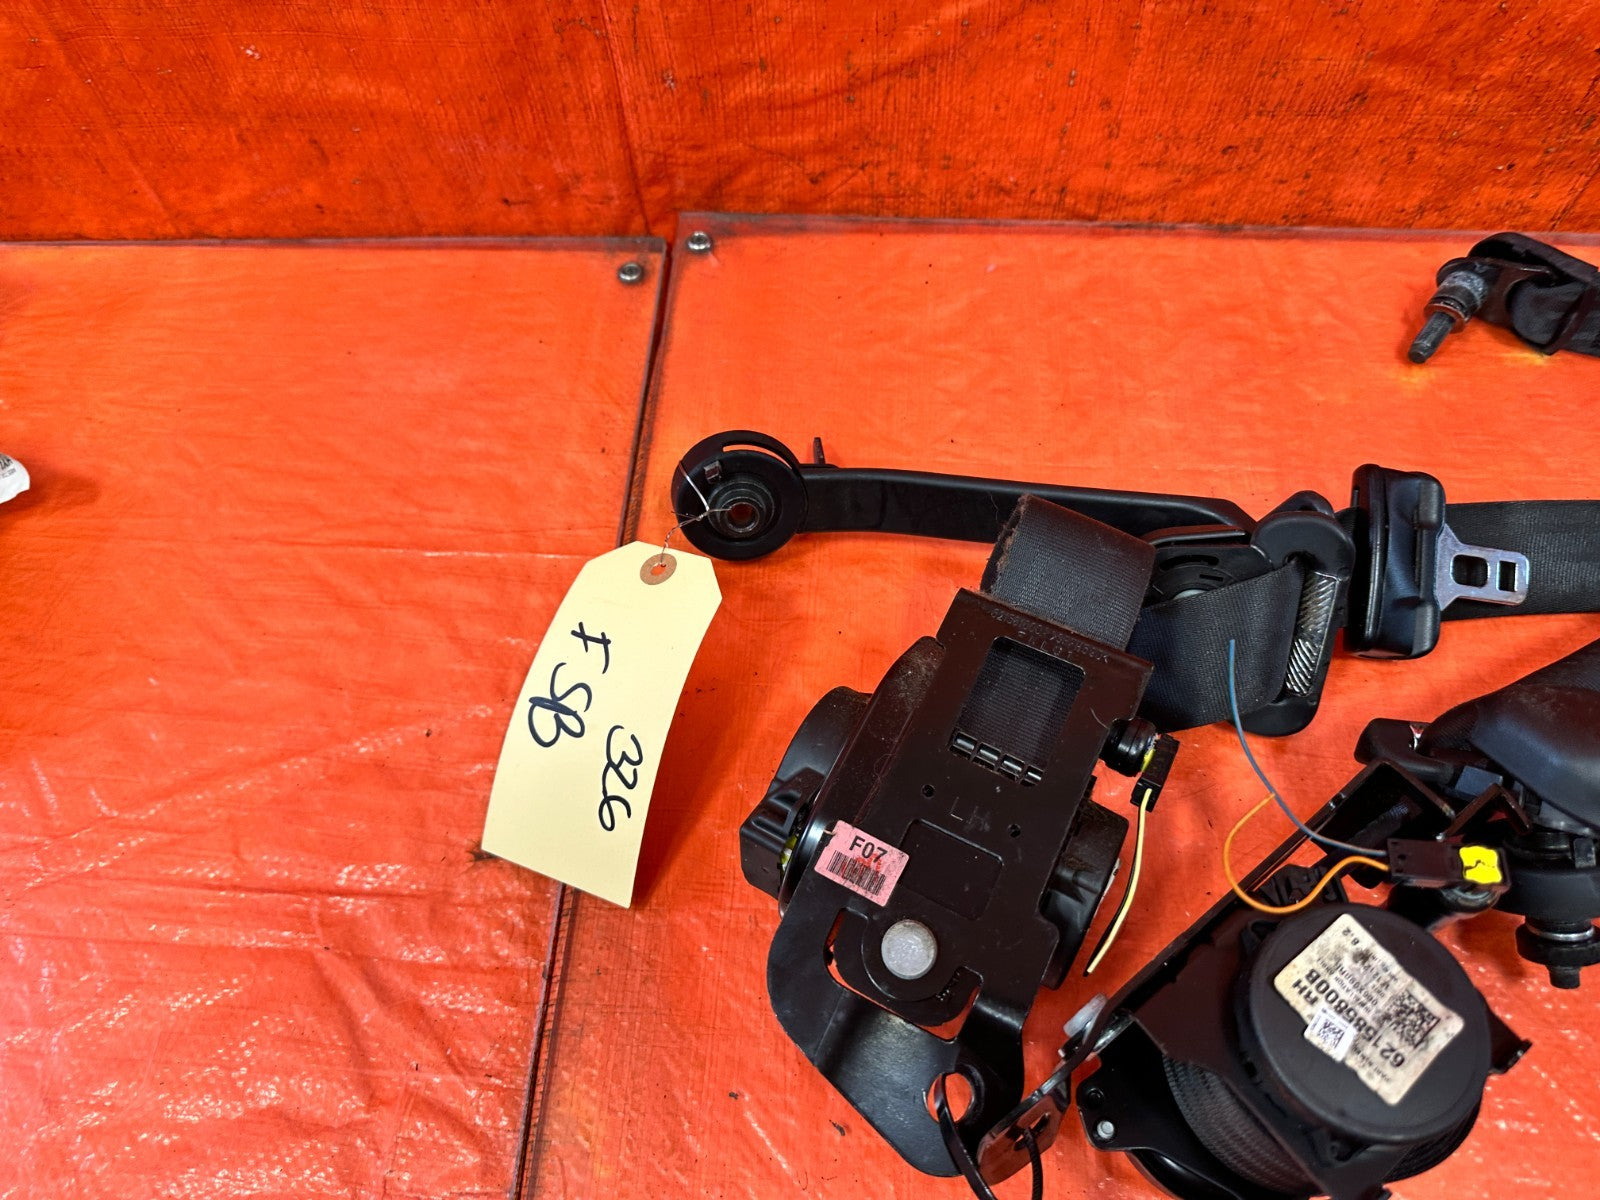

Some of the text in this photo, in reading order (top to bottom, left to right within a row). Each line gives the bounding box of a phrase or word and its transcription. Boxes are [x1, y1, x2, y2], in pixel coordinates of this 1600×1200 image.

[598, 724, 643, 832] 326
[848, 834, 889, 864] F07
[1291, 977, 1320, 1006] RH
